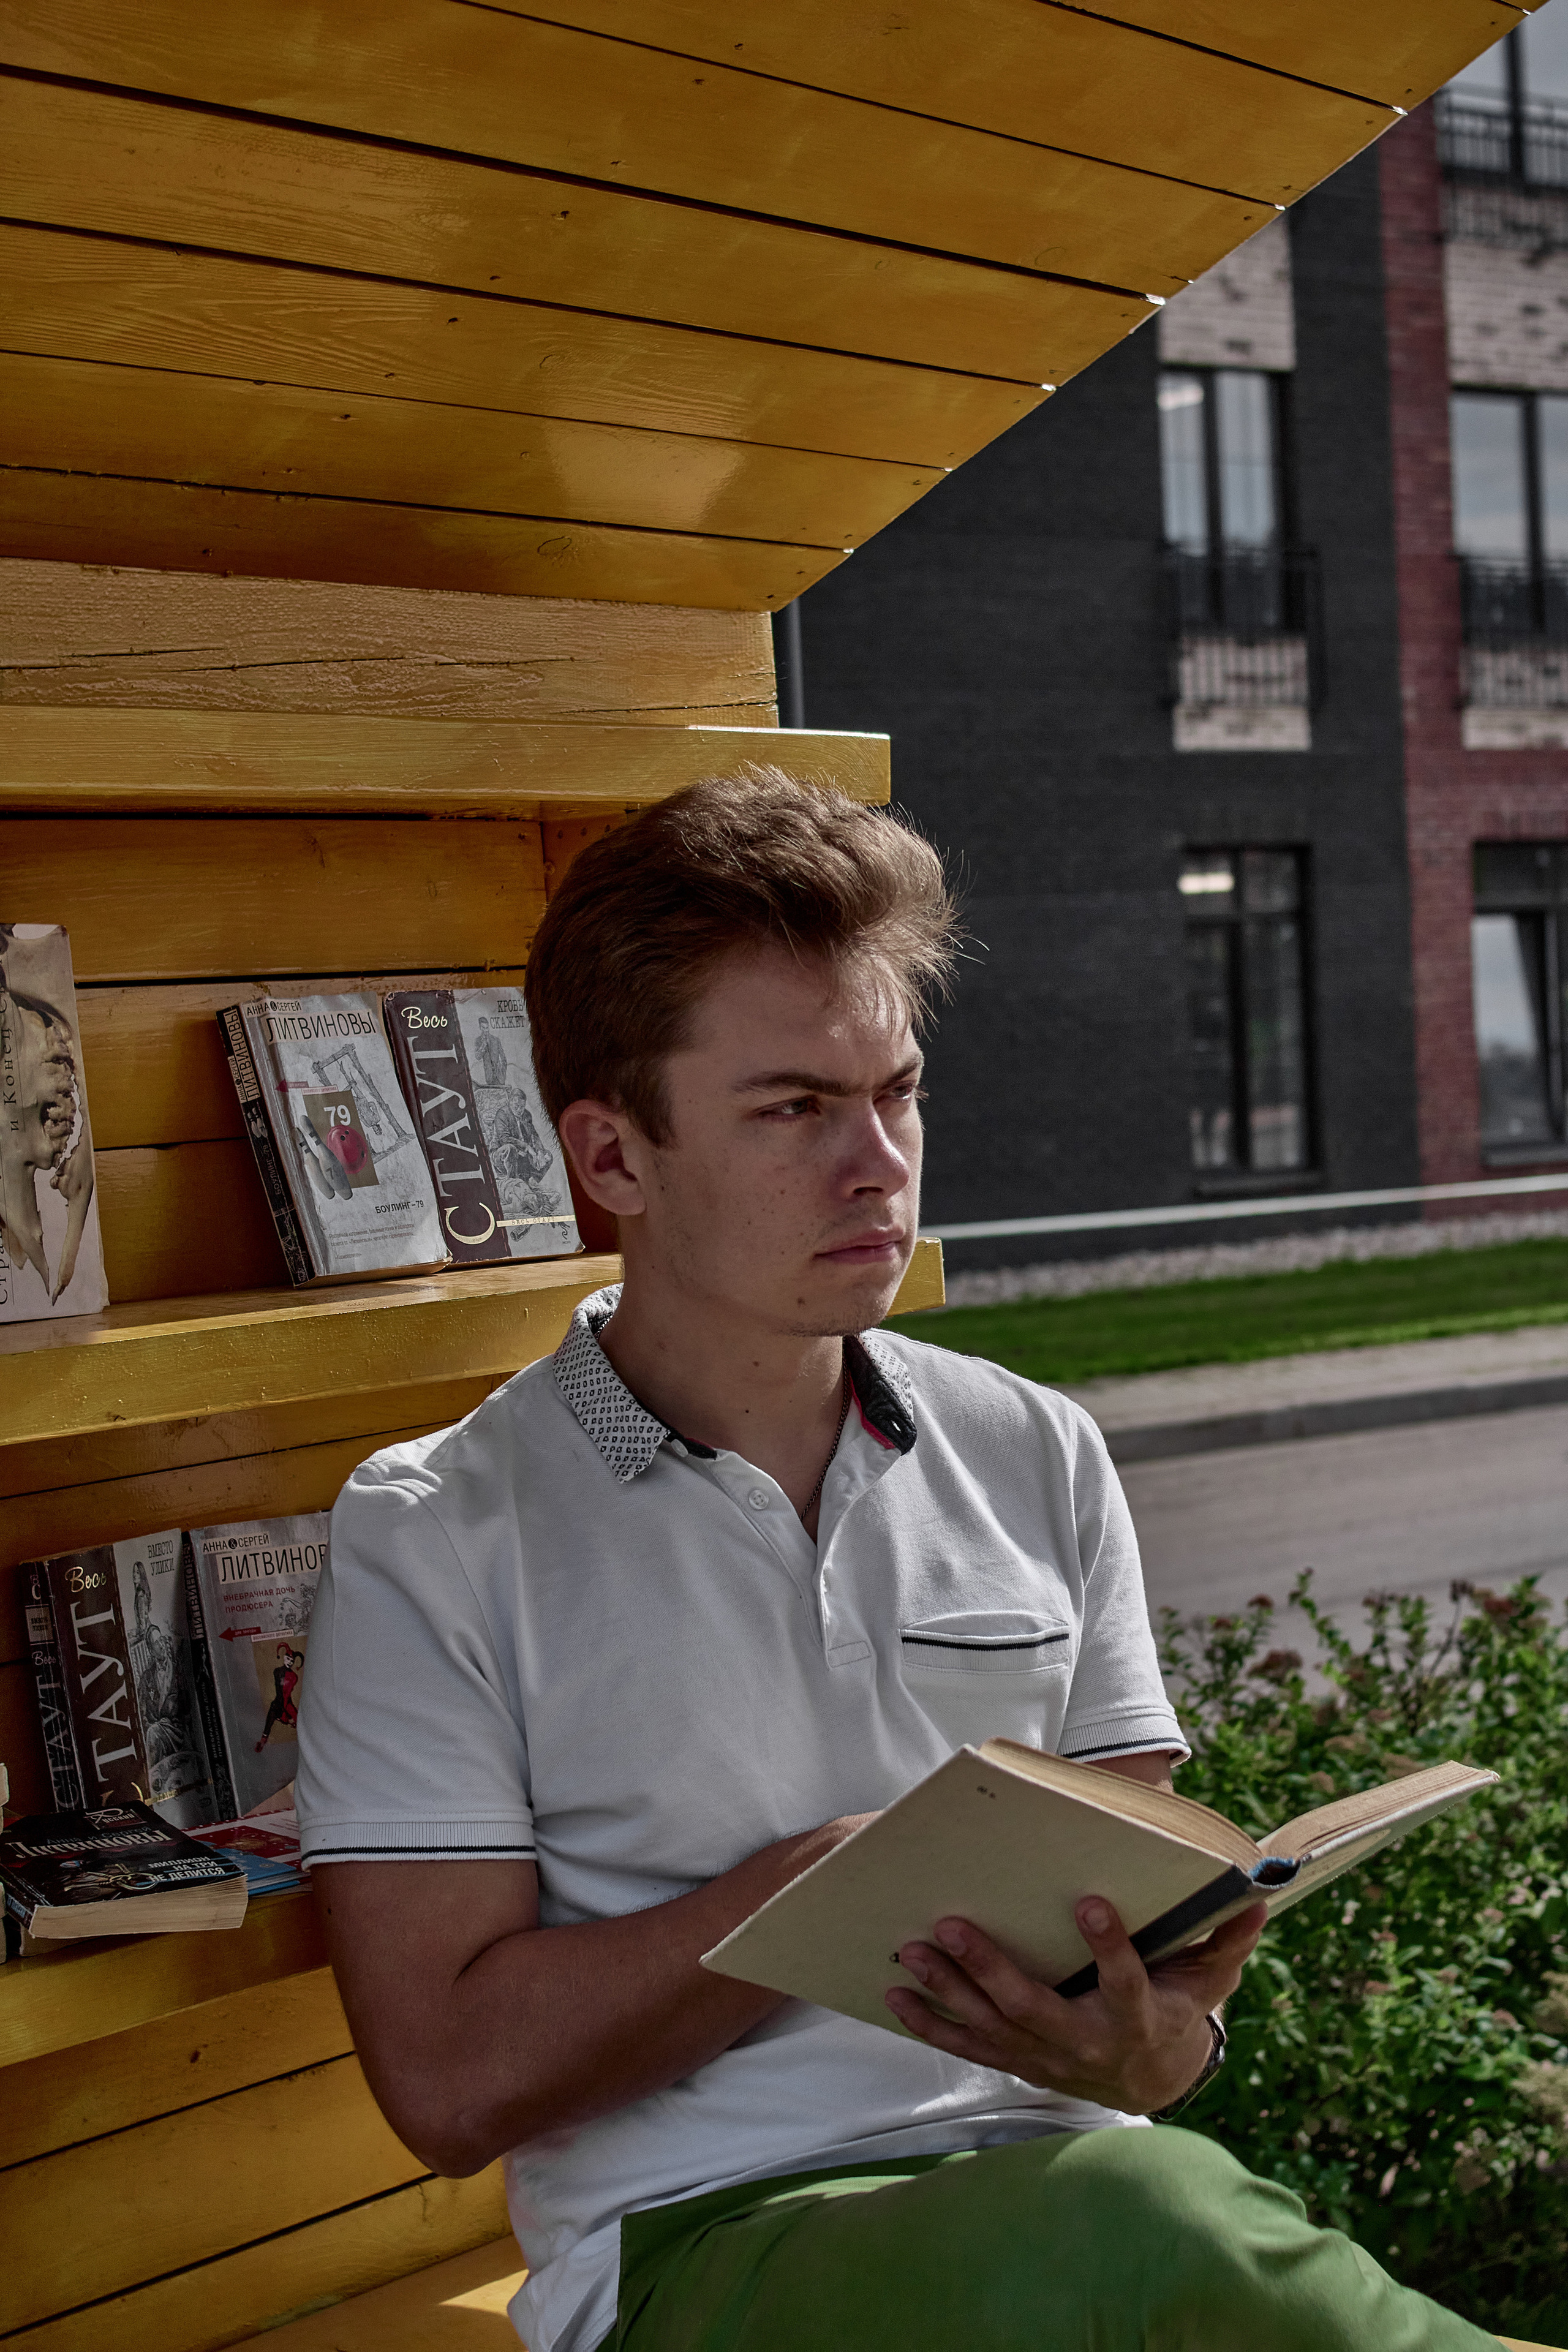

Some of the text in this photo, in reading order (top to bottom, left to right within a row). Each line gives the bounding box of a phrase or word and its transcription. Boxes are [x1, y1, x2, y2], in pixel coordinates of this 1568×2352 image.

[247, 1003, 269, 1016] АННА
[277, 1000, 302, 1012] СЕРГЕЙ
[497, 1000, 524, 1012] КРОВЬ
[266, 1011, 376, 1042] ЛИТВИНОВЫ
[401, 1006, 448, 1029] Весь
[490, 1016, 525, 1029] СКАЖЕТ
[225, 1010, 260, 1098] ЛИТВИНОВЫ
[1, 1028, 17, 1106] Конец
[229, 1058, 239, 1079] СЕРГЕЙ
[323, 1104, 351, 1128] 79
[9, 1120, 19, 1133] и
[407, 1036, 496, 1245] СТАУТ
[147, 1539, 173, 1559] ВМЕСТО
[203, 1540, 228, 1553] АННА
[238, 1532, 270, 1548] СЕРГЕЙ
[150, 1559, 175, 1577] УЛИКИ
[65, 1566, 107, 1593] Весь
[224, 1586, 296, 1602] ВНЕБРАЧНАЯ ДОЧЬ
[225, 1600, 274, 1613] ПРОДЮСЕРА
[36, 1675, 79, 1810] СТАУТ
[148, 1856, 211, 1868] МИЛЛИОН
[148, 1867, 226, 1882] НЕ ДЕЛИТСЯ
